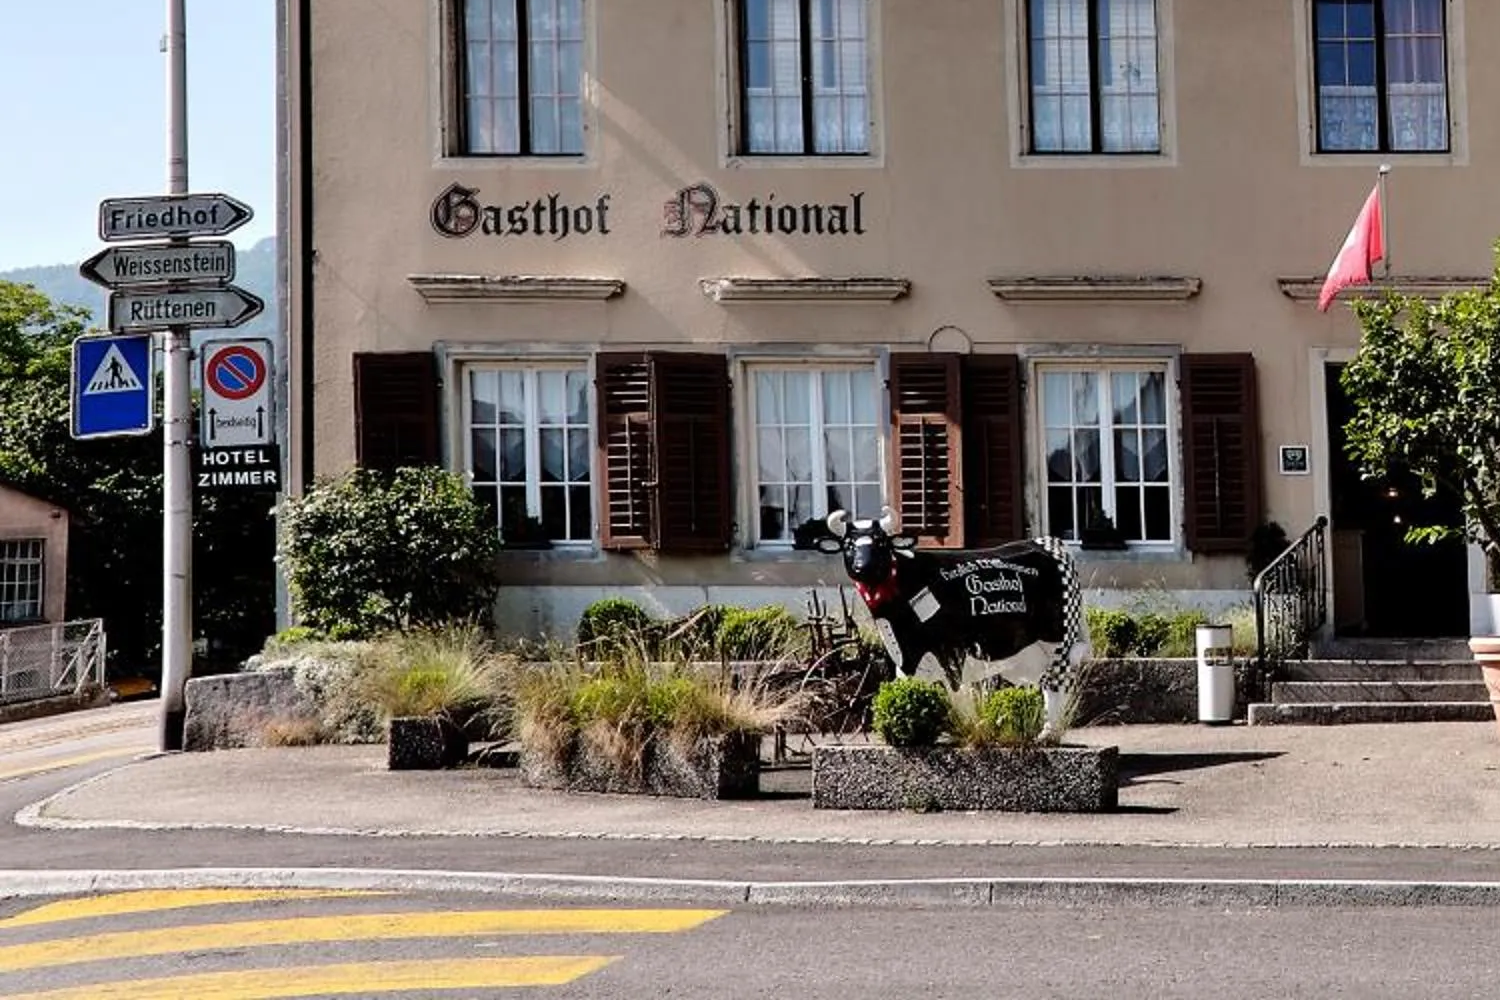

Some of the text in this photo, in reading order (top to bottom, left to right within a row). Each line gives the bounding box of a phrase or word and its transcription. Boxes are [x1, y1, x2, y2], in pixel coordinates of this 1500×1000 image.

[111, 204, 220, 230] Friedhof
[430, 181, 867, 241] Gasthof National
[113, 254, 226, 277] Weissenstein
[131, 299, 216, 321] Rüttenen
[202, 451, 270, 465] HOTEL
[198, 471, 277, 487] ZIMMER
[965, 571, 1023, 595] Gasthof
